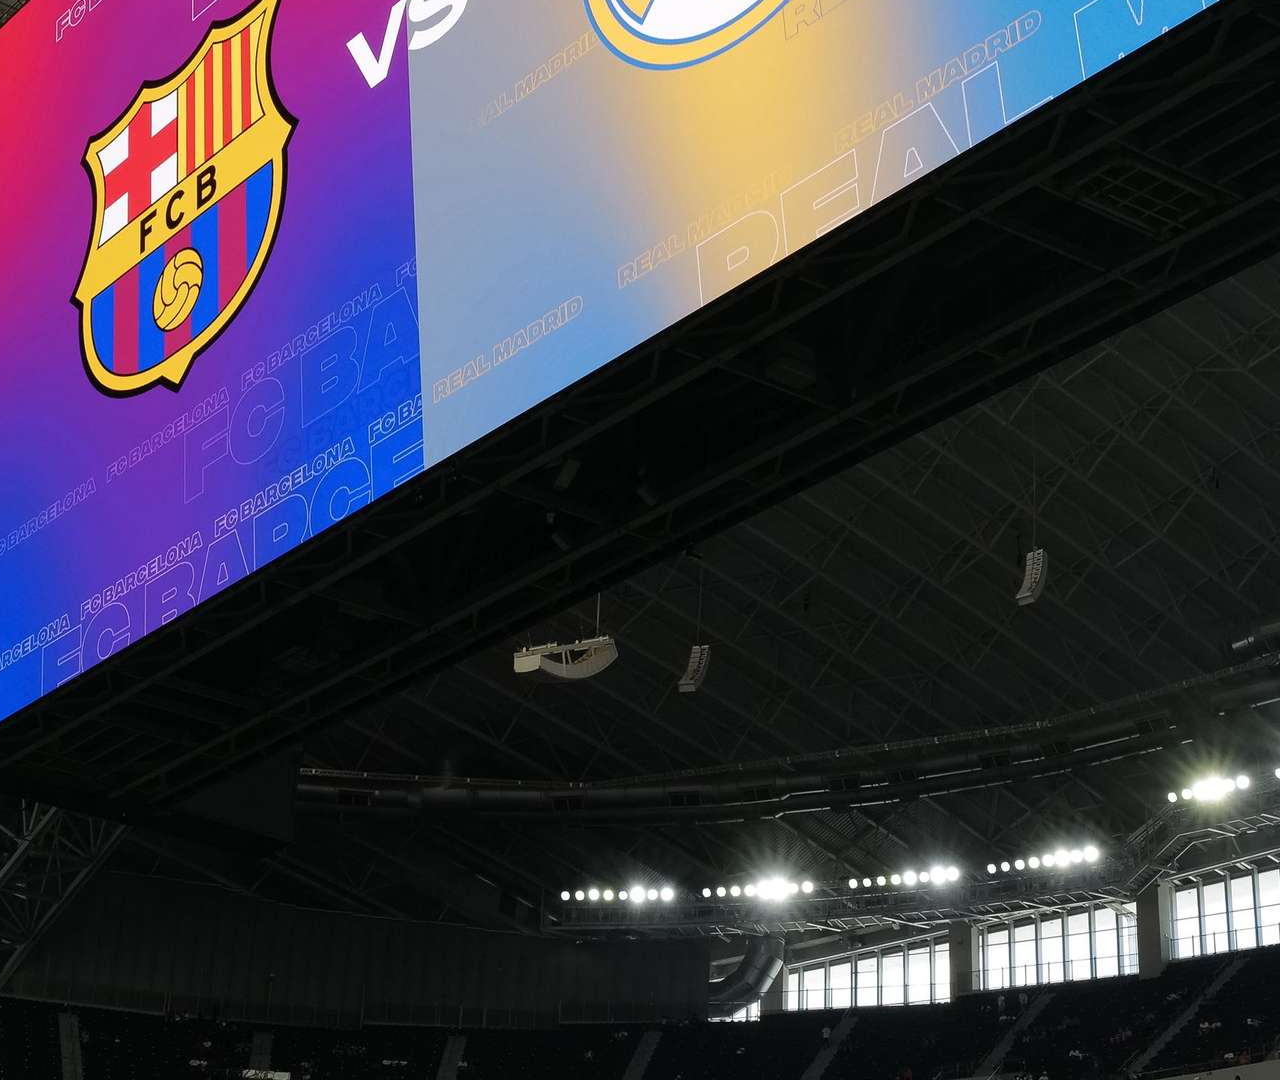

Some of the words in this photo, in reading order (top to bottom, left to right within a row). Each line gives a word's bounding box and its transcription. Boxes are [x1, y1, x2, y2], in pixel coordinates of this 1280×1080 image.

[918, 10, 1041, 102] MADRID
[140, 164, 217, 255] FCB
[492, 295, 583, 369] MADRID
[101, 530, 203, 612] BARCELONA
[240, 435, 356, 521] BARCELONA
